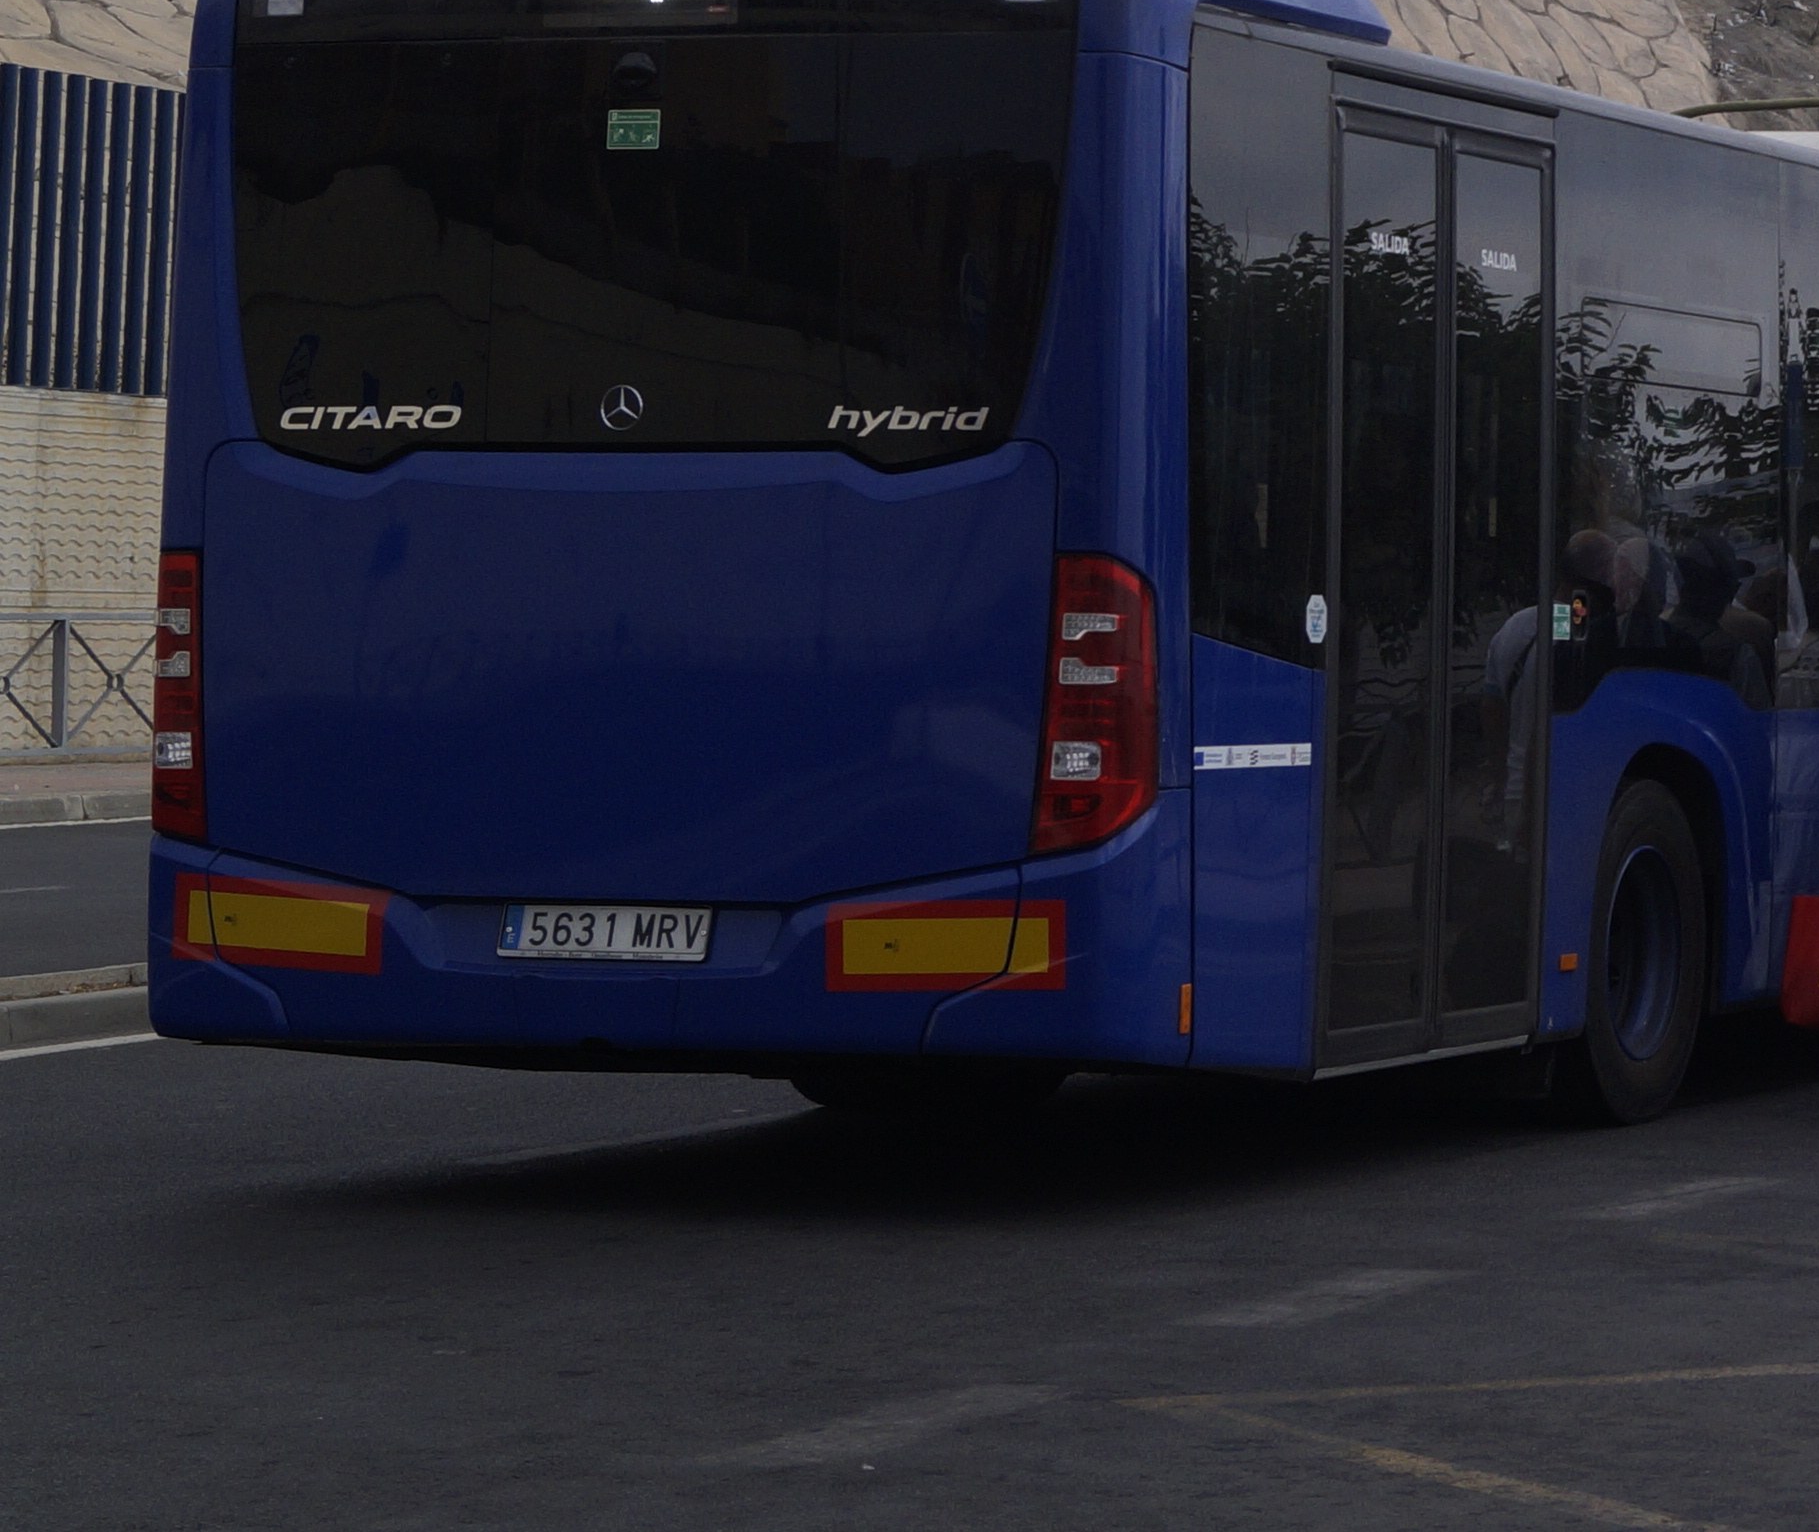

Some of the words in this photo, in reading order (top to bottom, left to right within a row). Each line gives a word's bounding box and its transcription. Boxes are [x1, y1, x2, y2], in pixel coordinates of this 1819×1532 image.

[1371, 232, 1410, 256] SALIDA
[1481, 249, 1518, 272] SALIDA
[280, 404, 462, 430] CITARO
[827, 405, 990, 437] hybrid
[507, 932, 516, 944] E
[528, 911, 617, 948] 5631
[631, 913, 705, 949] MRV
